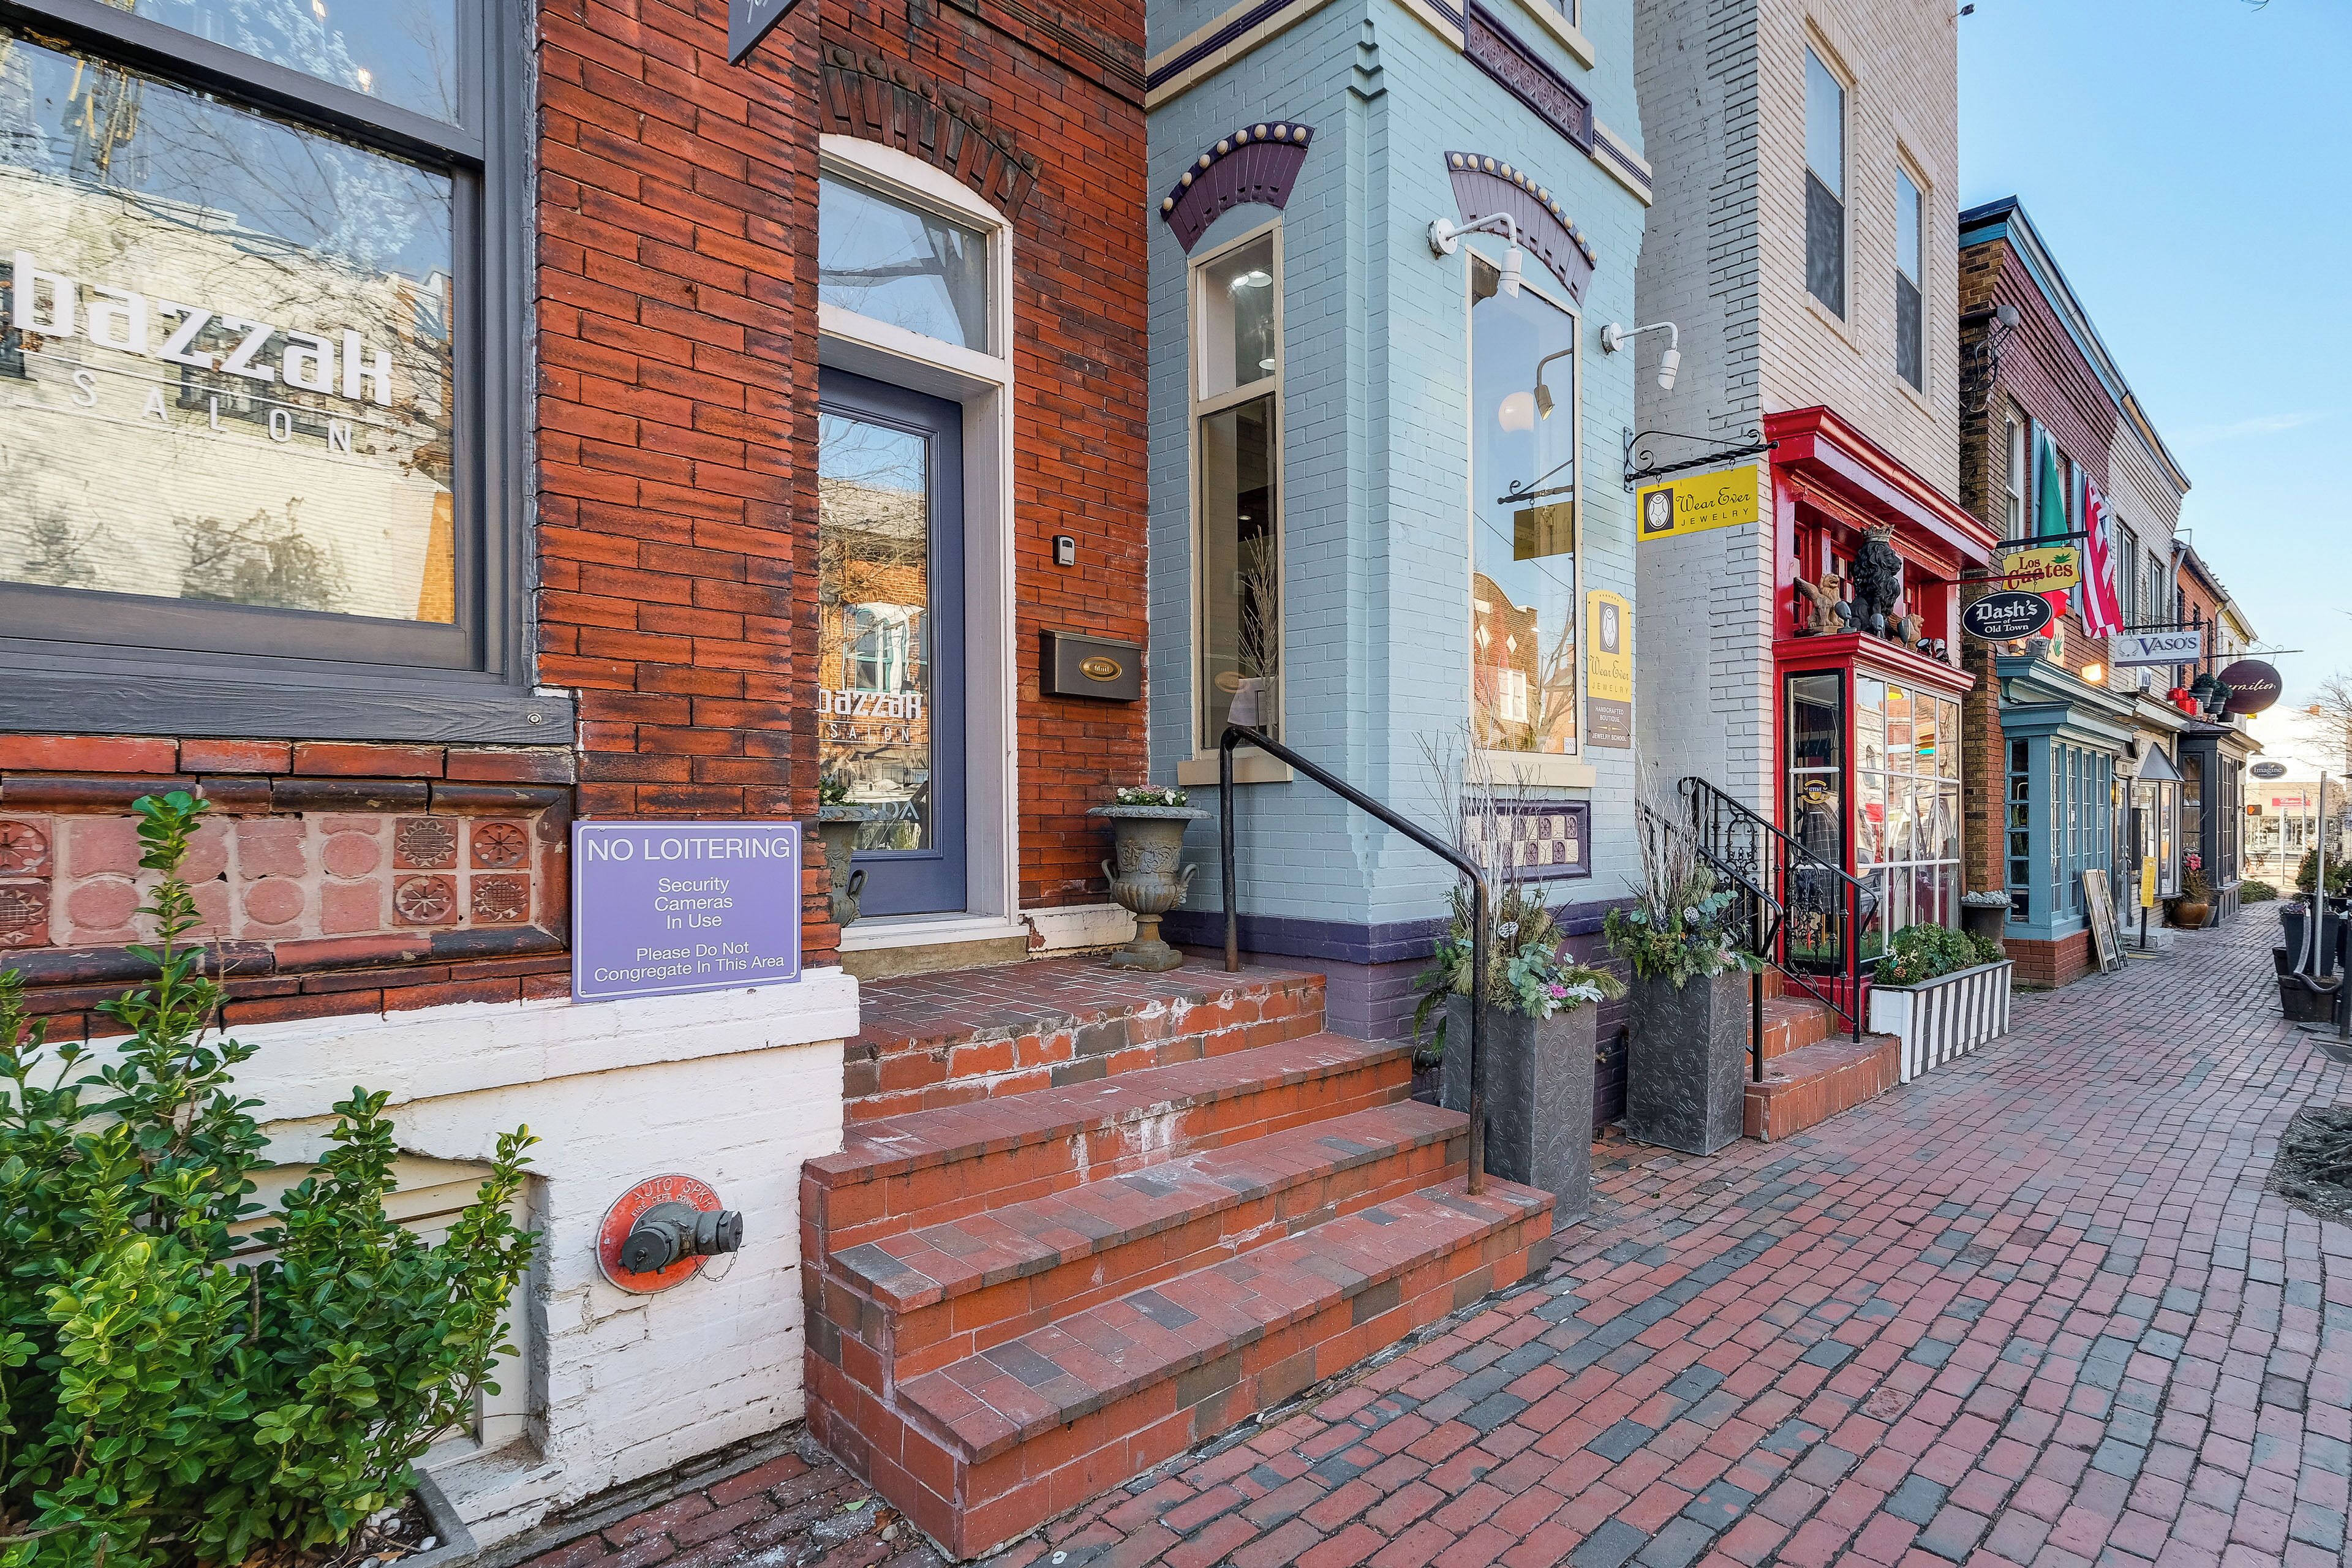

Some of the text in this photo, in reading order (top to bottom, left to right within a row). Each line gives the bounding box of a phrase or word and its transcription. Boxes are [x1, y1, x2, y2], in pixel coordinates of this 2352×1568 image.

[12, 249, 393, 407] bazzak
[72, 368, 352, 454] SALON
[1675, 487, 1751, 513] Wear Ever
[1681, 508, 1749, 526] JEWELRY
[2018, 556, 2040, 570] Los
[1975, 600, 2038, 621] Dash's
[1985, 625, 2002, 633] Old
[2136, 637, 2197, 656] VASO'S
[1589, 655, 1629, 680] Wear Ever
[1592, 682, 1629, 694] JEWELRY
[2228, 679, 2276, 691] rmilion
[1595, 706, 1624, 715] HANDCRAFTED
[1599, 714, 1620, 723] BOUTIQUE
[830, 723, 910, 742] SALON
[587, 837, 791, 861] NO LOITERING
[658, 876, 729, 894] Security
[654, 896, 733, 911] Cameras
[666, 913, 723, 930] In Use
[636, 941, 749, 962] Please Do Not
[594, 955, 785, 982] Congregate In This Area
[633, 1178, 673, 1200] AUTO
[631, 1202, 647, 1217] FIRE
[676, 1194, 701, 1212] CONNEC
